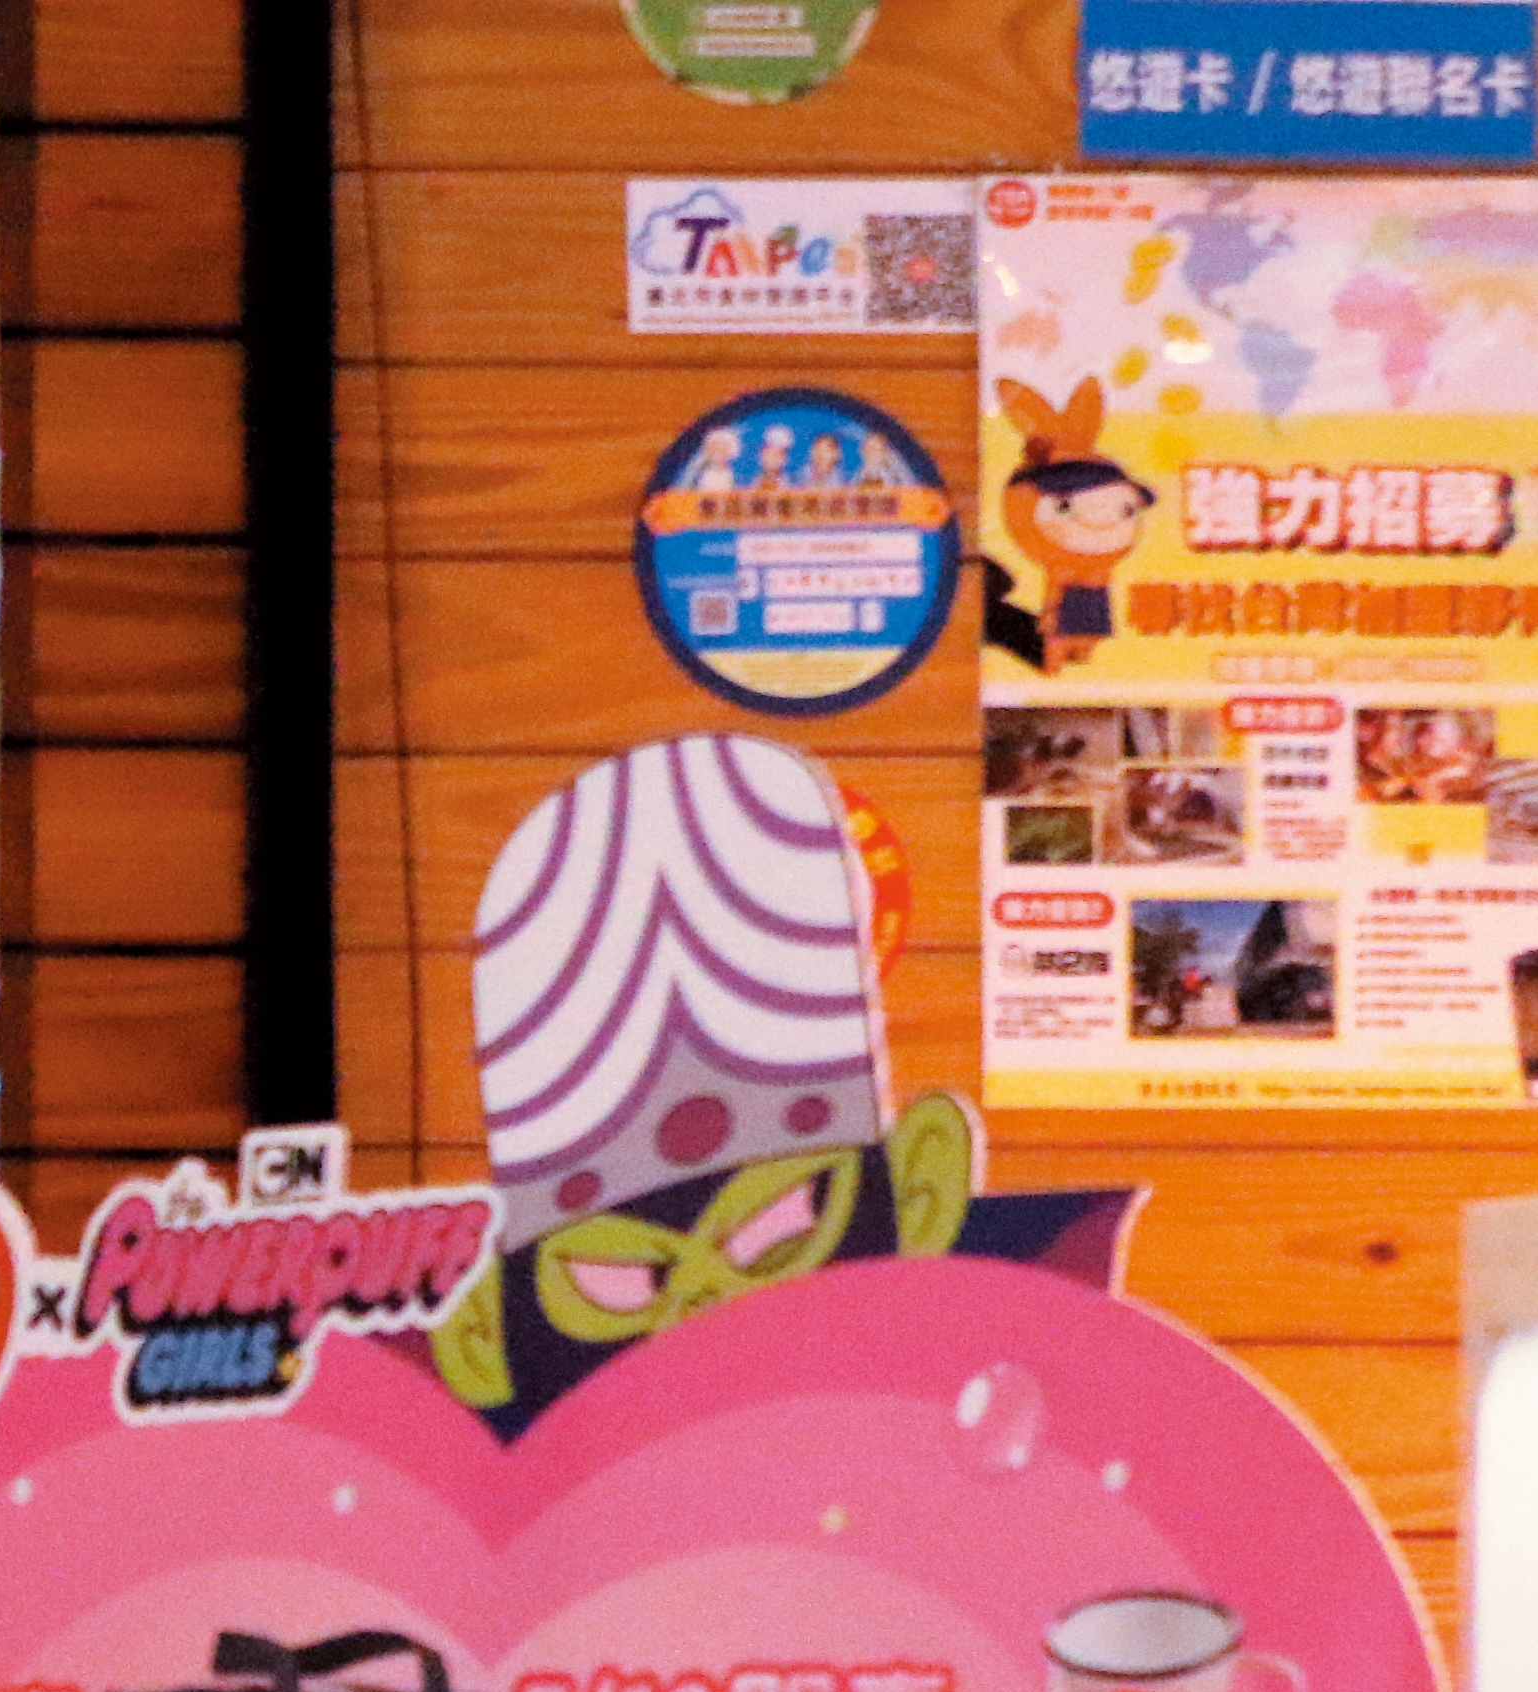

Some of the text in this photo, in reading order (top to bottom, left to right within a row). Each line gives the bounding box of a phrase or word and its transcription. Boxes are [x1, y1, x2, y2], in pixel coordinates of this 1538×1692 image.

[1183, 464, 1505, 552] 強力招募
[134, 1322, 281, 1393] GIRLS
